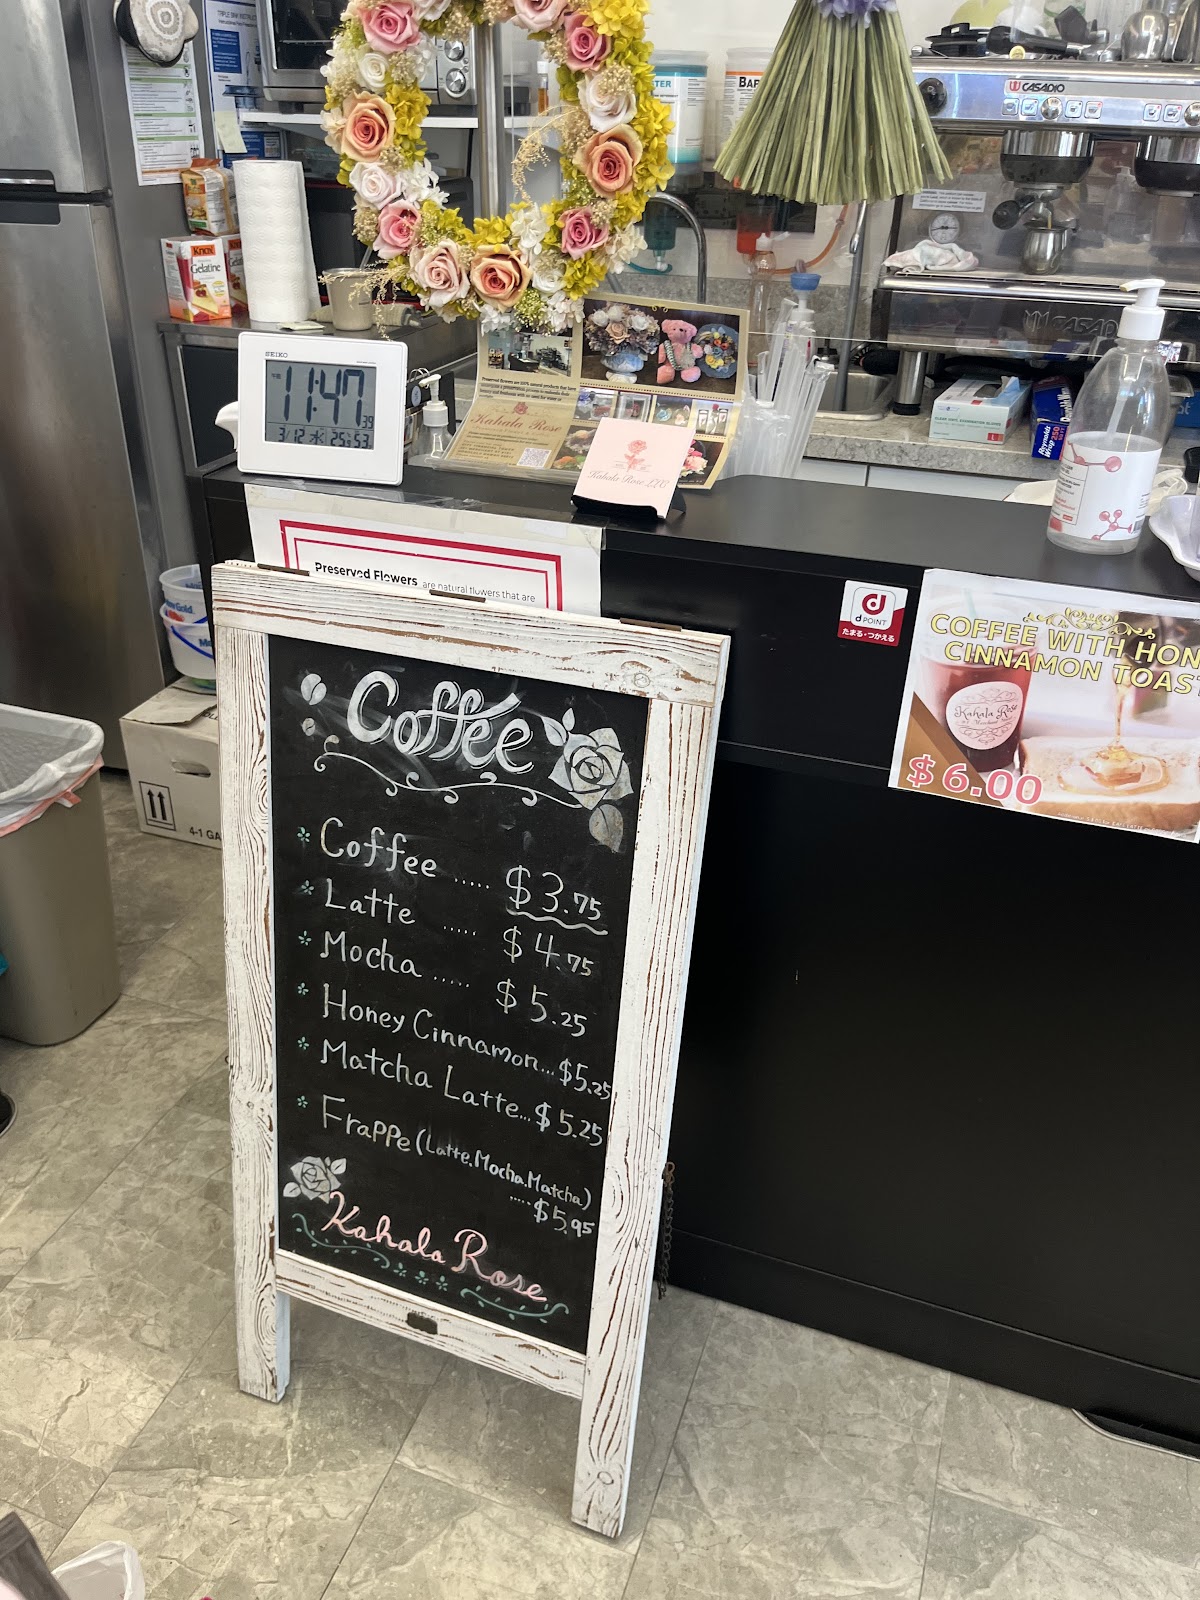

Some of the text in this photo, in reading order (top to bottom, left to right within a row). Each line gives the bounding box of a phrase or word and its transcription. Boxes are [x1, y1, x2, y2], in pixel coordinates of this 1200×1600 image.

[1022, 82, 1065, 92] CASADIO
[193, 246, 213, 255] Knox
[191, 264, 221, 273] Gelatine
[1052, 315, 1118, 338] CASAD
[283, 366, 365, 427] 11:47
[362, 415, 374, 429] 39
[471, 414, 523, 429] Kahala
[528, 420, 562, 432] Rose
[1052, 426, 1060, 440] 250
[278, 427, 305, 444] 3/12
[1038, 425, 1051, 455] Reynolds
[1043, 439, 1056, 458] Wrap
[588, 470, 619, 482] Kahala
[621, 474, 645, 486] Rose
[315, 562, 536, 603] Preserved Flowers are natural flowers that are
[863, 617, 887, 626] POINT
[930, 613, 1038, 647] COFFEE
[1048, 629, 1126, 659] WITH
[944, 641, 1200, 697] CINNAMON TOAS
[347, 670, 534, 774] Coffee
[954, 704, 1018, 720] Kahala Rose
[206, 830, 221, 841] GA
[320, 817, 437, 878] Coffee
[325, 878, 415, 925] Latte
[320, 930, 422, 978] Mocha
[323, 983, 405, 1033] Honey
[320, 1038, 433, 1089] Matcha
[323, 1094, 411, 1152] Frappe
[321, 1191, 548, 1302] Kahala Rose
